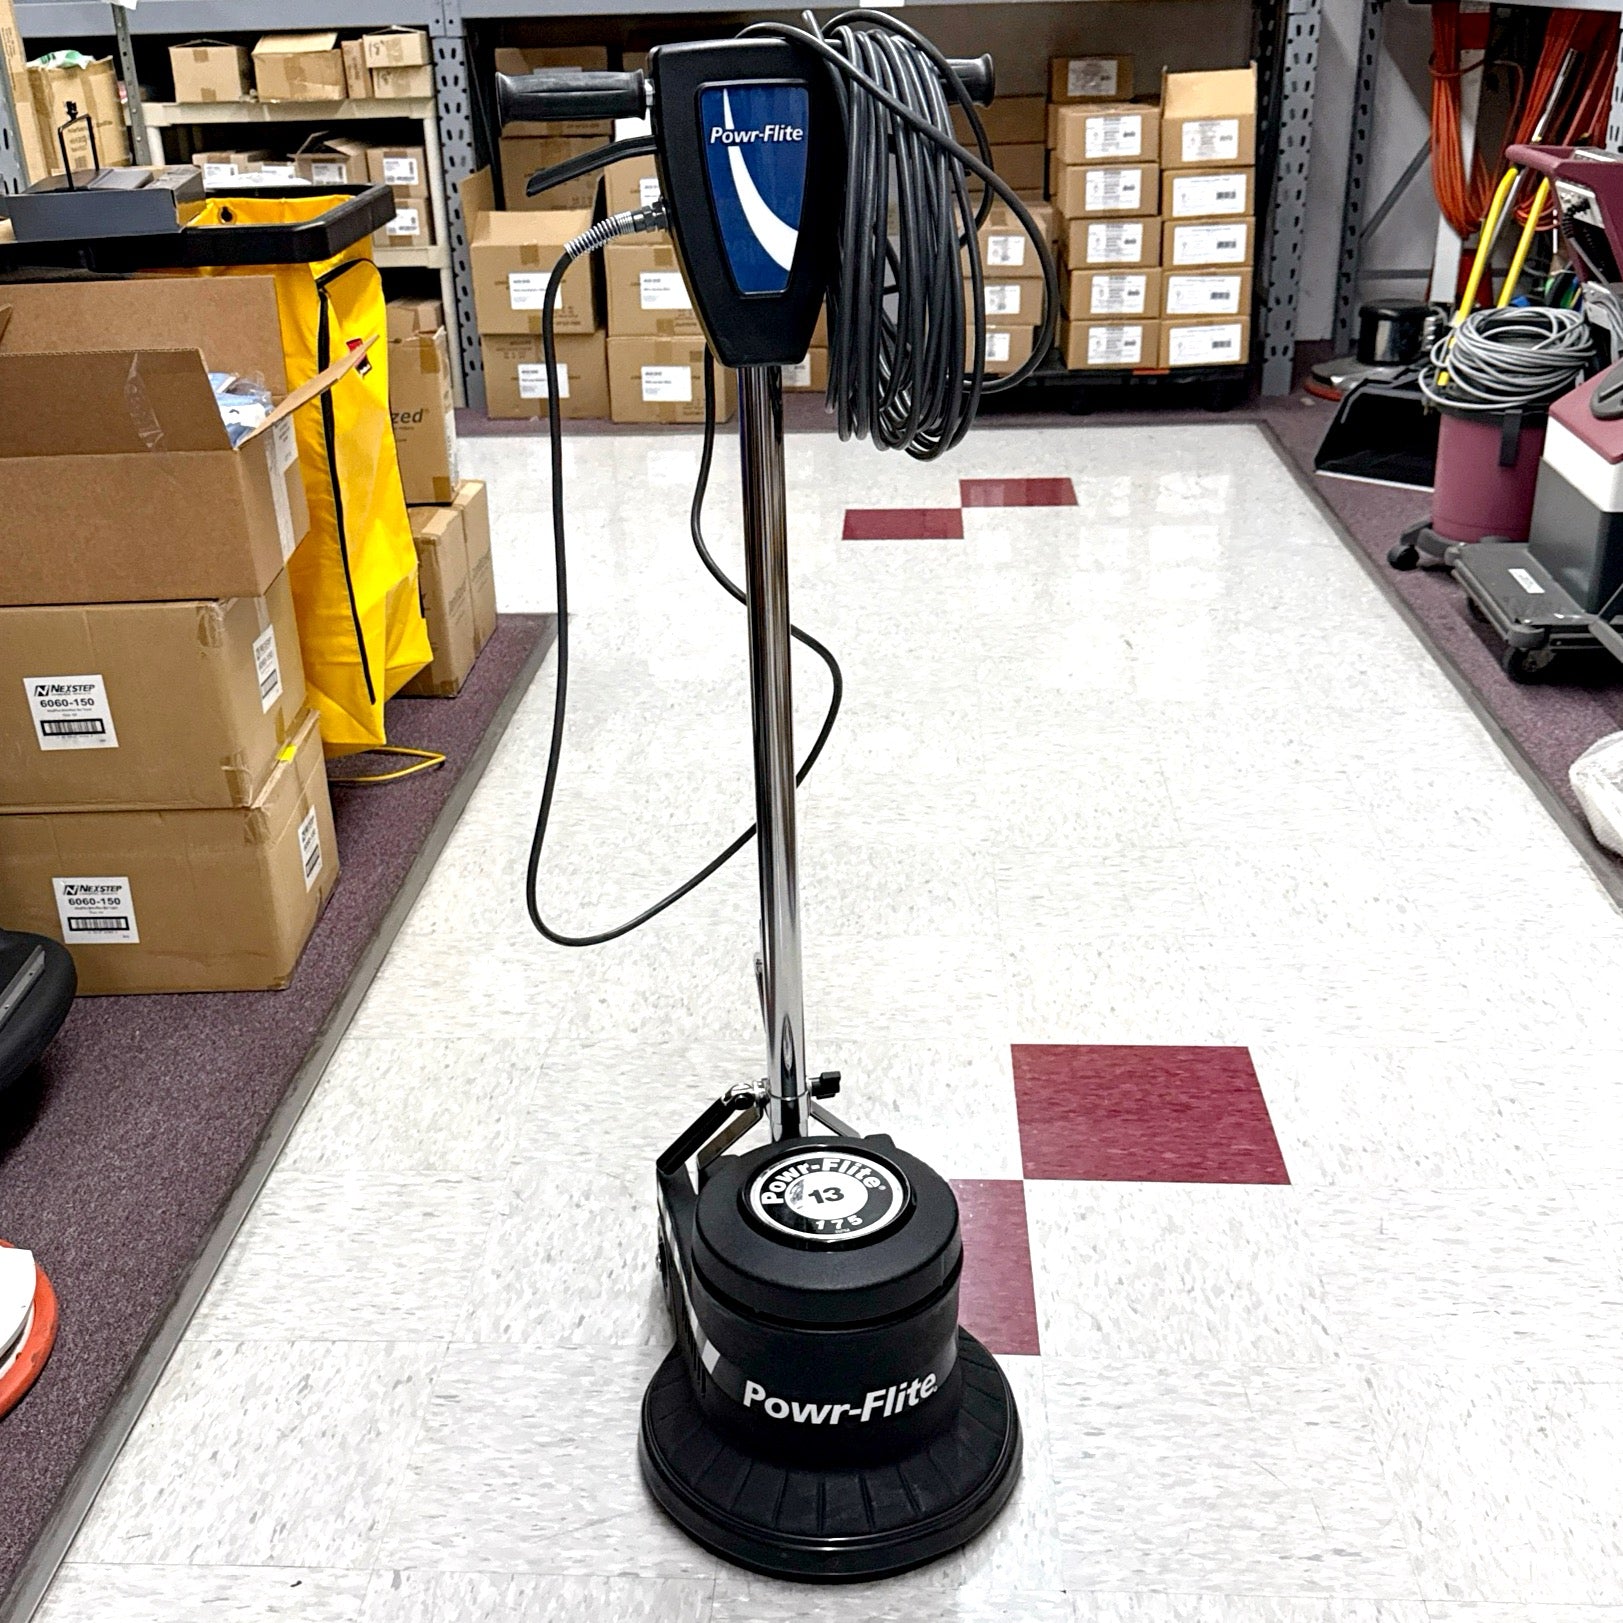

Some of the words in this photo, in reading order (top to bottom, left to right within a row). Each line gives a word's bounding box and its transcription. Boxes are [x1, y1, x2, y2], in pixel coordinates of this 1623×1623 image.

[710, 124, 804, 144] Powr-Flite
[51, 683, 96, 693] NEXSTEP
[40, 697, 95, 708] 6060-150
[79, 884, 123, 893] NEXSTEP
[68, 897, 121, 906] 6060-150
[761, 1157, 883, 1206] Powr-Flite
[808, 1186, 845, 1204] 13
[815, 1214, 864, 1231] 175
[742, 1372, 938, 1426] Powr-Flite
